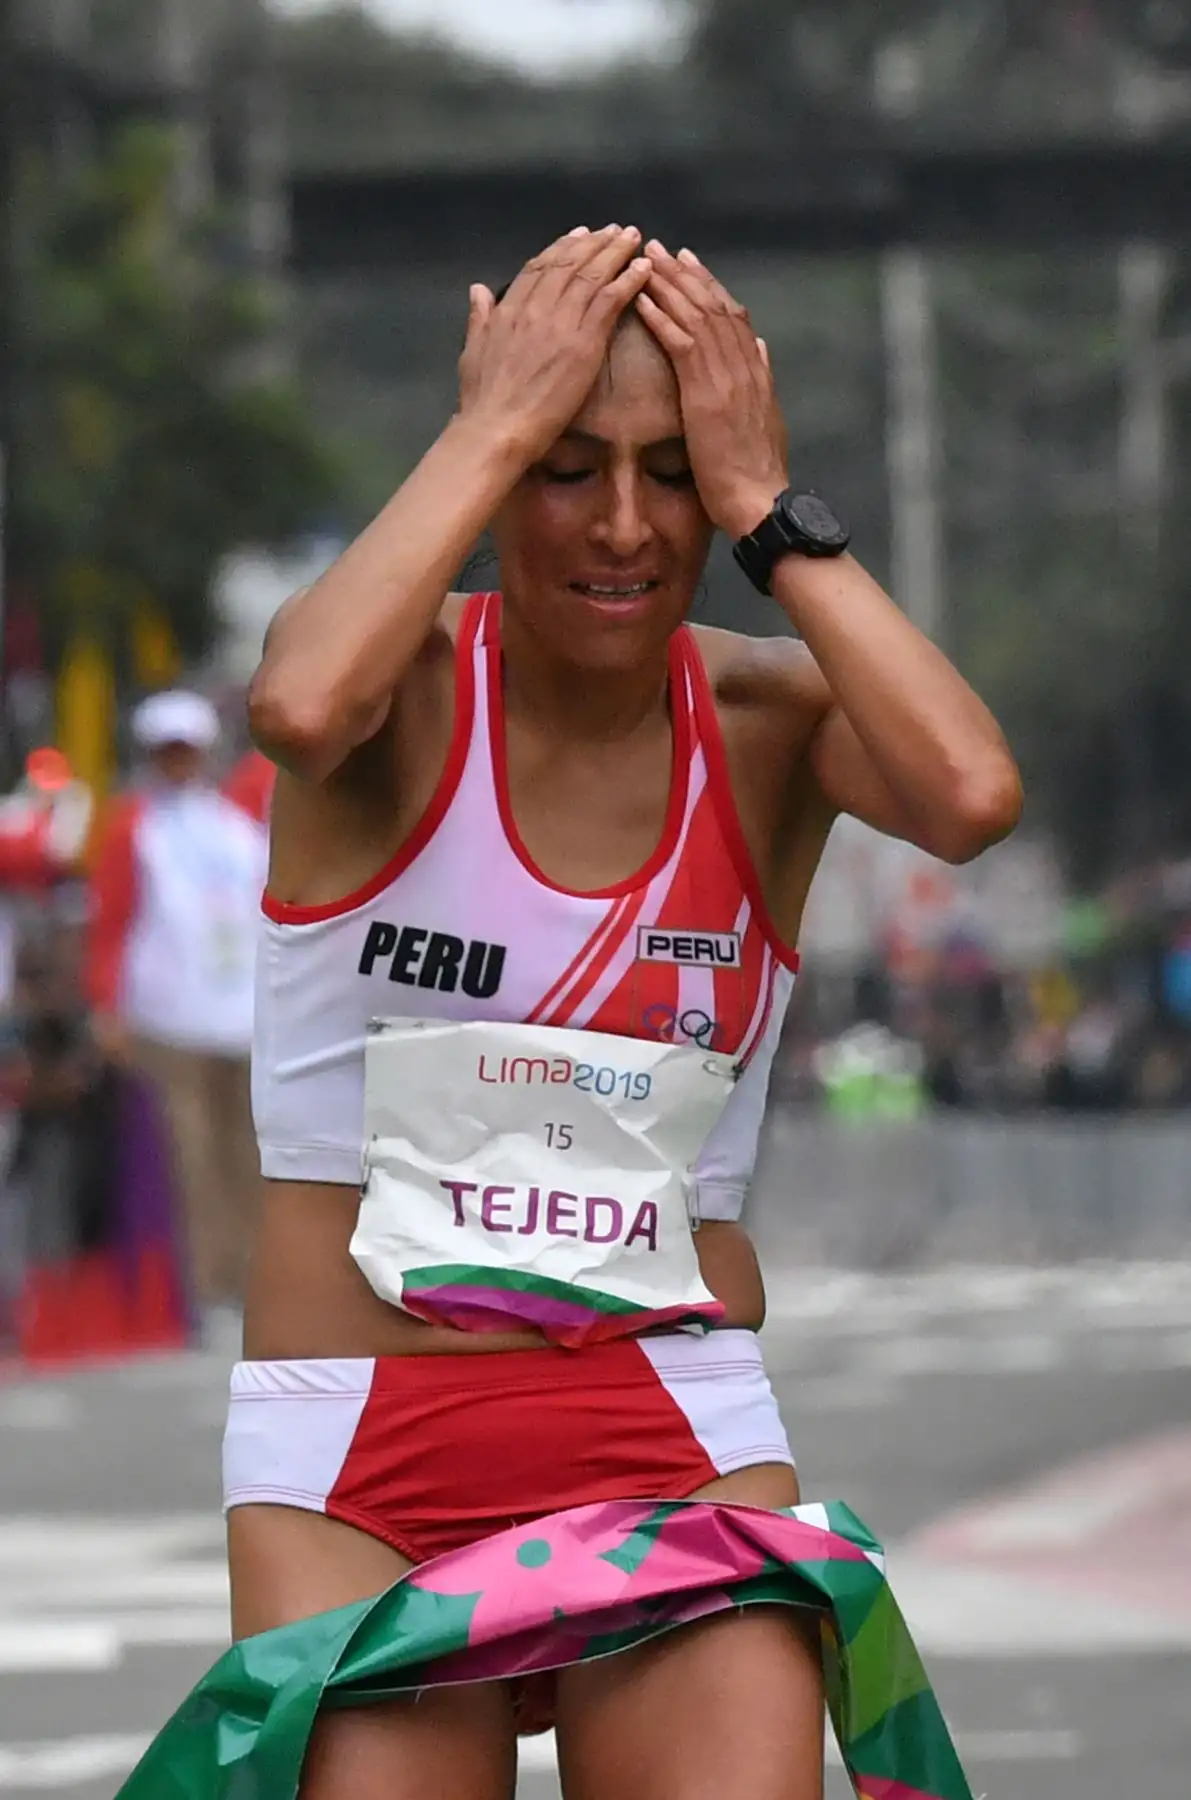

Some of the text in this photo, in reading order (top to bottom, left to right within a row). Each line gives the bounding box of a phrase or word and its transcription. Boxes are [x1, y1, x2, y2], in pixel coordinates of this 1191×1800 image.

[357, 921, 506, 998] PERU
[647, 935, 735, 962] PERU
[544, 1122, 574, 1151] 15
[439, 1180, 658, 1251] TEJEDA
